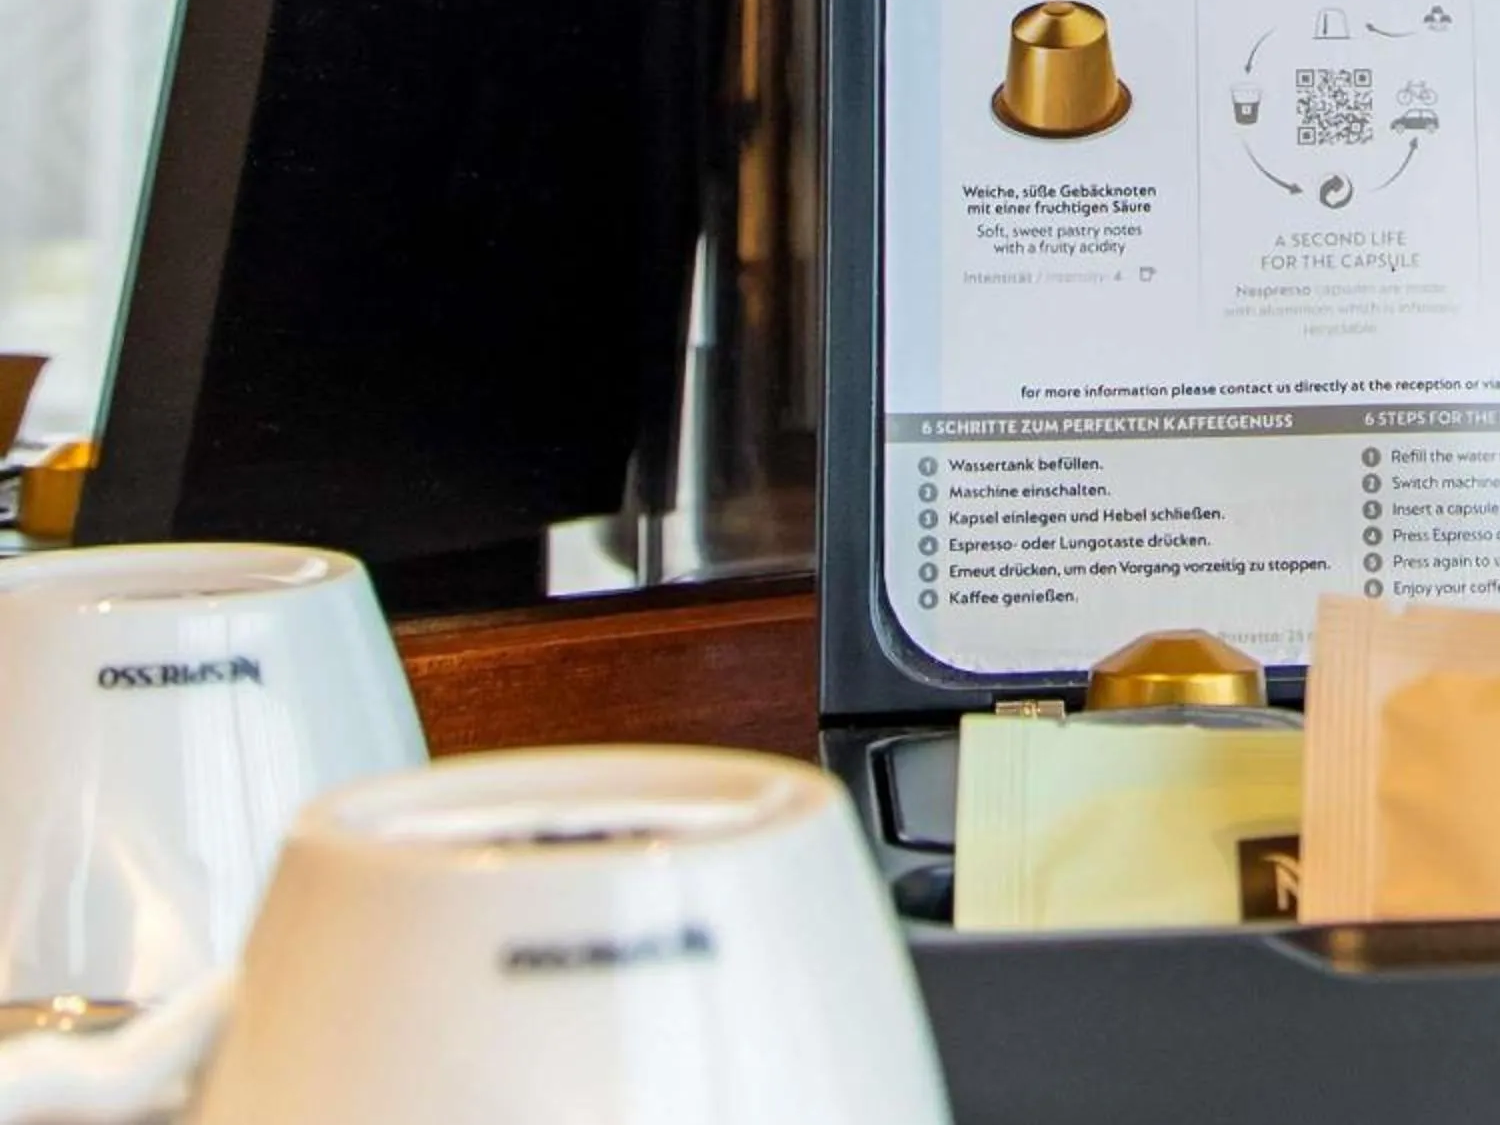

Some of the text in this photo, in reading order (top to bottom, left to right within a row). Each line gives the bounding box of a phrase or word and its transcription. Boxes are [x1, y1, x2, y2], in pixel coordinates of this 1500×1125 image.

[962, 184, 1156, 200] Weiche, süße Gebäcknoten
[967, 201, 1151, 217] mit einer fruchtigen Säure
[976, 224, 1142, 240] Soft, sweet pastry notes
[1274, 231, 1407, 248] A SECOND LIFE
[994, 240, 1126, 256] with a fruity acidity
[1260, 252, 1420, 271] FOR THE CAPSULE
[1021, 385, 1040, 399] for
[1045, 388, 1081, 399] more
[1085, 384, 1168, 397] information
[1171, 383, 1216, 398] please
[1219, 383, 1271, 395] contact
[1277, 384, 1291, 394] us
[1294, 379, 1348, 394] directly
[1351, 380, 1365, 392] at
[1369, 379, 1392, 392] the
[1395, 379, 1461, 393] reception
[1465, 380, 1480, 391] or
[921, 413, 1293, 435] 6 SCHRITTE ZUM PERFEKTEN KAFFEEGENUSS
[1364, 412, 1375, 426] 6
[1378, 410, 1426, 426] STEPS
[1429, 410, 1462, 425] FOR
[1465, 410, 1496, 425] THE
[948, 458, 1034, 472] Wassertank
[1038, 456, 1104, 471] befüllen.
[1392, 449, 1427, 463] Refill
[1430, 449, 1454, 463] the
[1457, 450, 1497, 463] water
[949, 484, 1019, 498] Maschine
[1022, 483, 1111, 497] einschalten.
[1392, 475, 1438, 490] Switch
[1442, 475, 1500, 489] machine
[949, 510, 999, 527] Kapsel
[1002, 510, 1067, 527] einlegen
[1071, 509, 1099, 522] und
[1103, 508, 1147, 523] Hebel
[1150, 506, 1226, 521] schließen.
[1392, 502, 1432, 516] Insert
[1435, 504, 1444, 515] a
[1447, 501, 1500, 518] capsule
[1021, 536, 1056, 550] oder
[1060, 536, 1144, 552] Lungotaste
[1147, 533, 1212, 548] drücken.
[1393, 528, 1430, 542] Press
[1433, 527, 1494, 544] Espresso
[1000, 563, 1061, 578] drücken,
[1064, 565, 1086, 576] um
[1089, 562, 1117, 575] den
[1119, 560, 1181, 577] Vorgang
[1184, 558, 1246, 575] vorzeitig
[1249, 560, 1265, 572] zu
[1269, 559, 1331, 575] stoppen.
[1393, 554, 1430, 568] Press
[1433, 555, 1472, 571] again
[1475, 555, 1490, 568] to
[949, 590, 999, 604] Kaffee
[1002, 588, 1078, 607] genießen.
[1393, 580, 1433, 598] Enjoy
[1435, 582, 1466, 597] your
